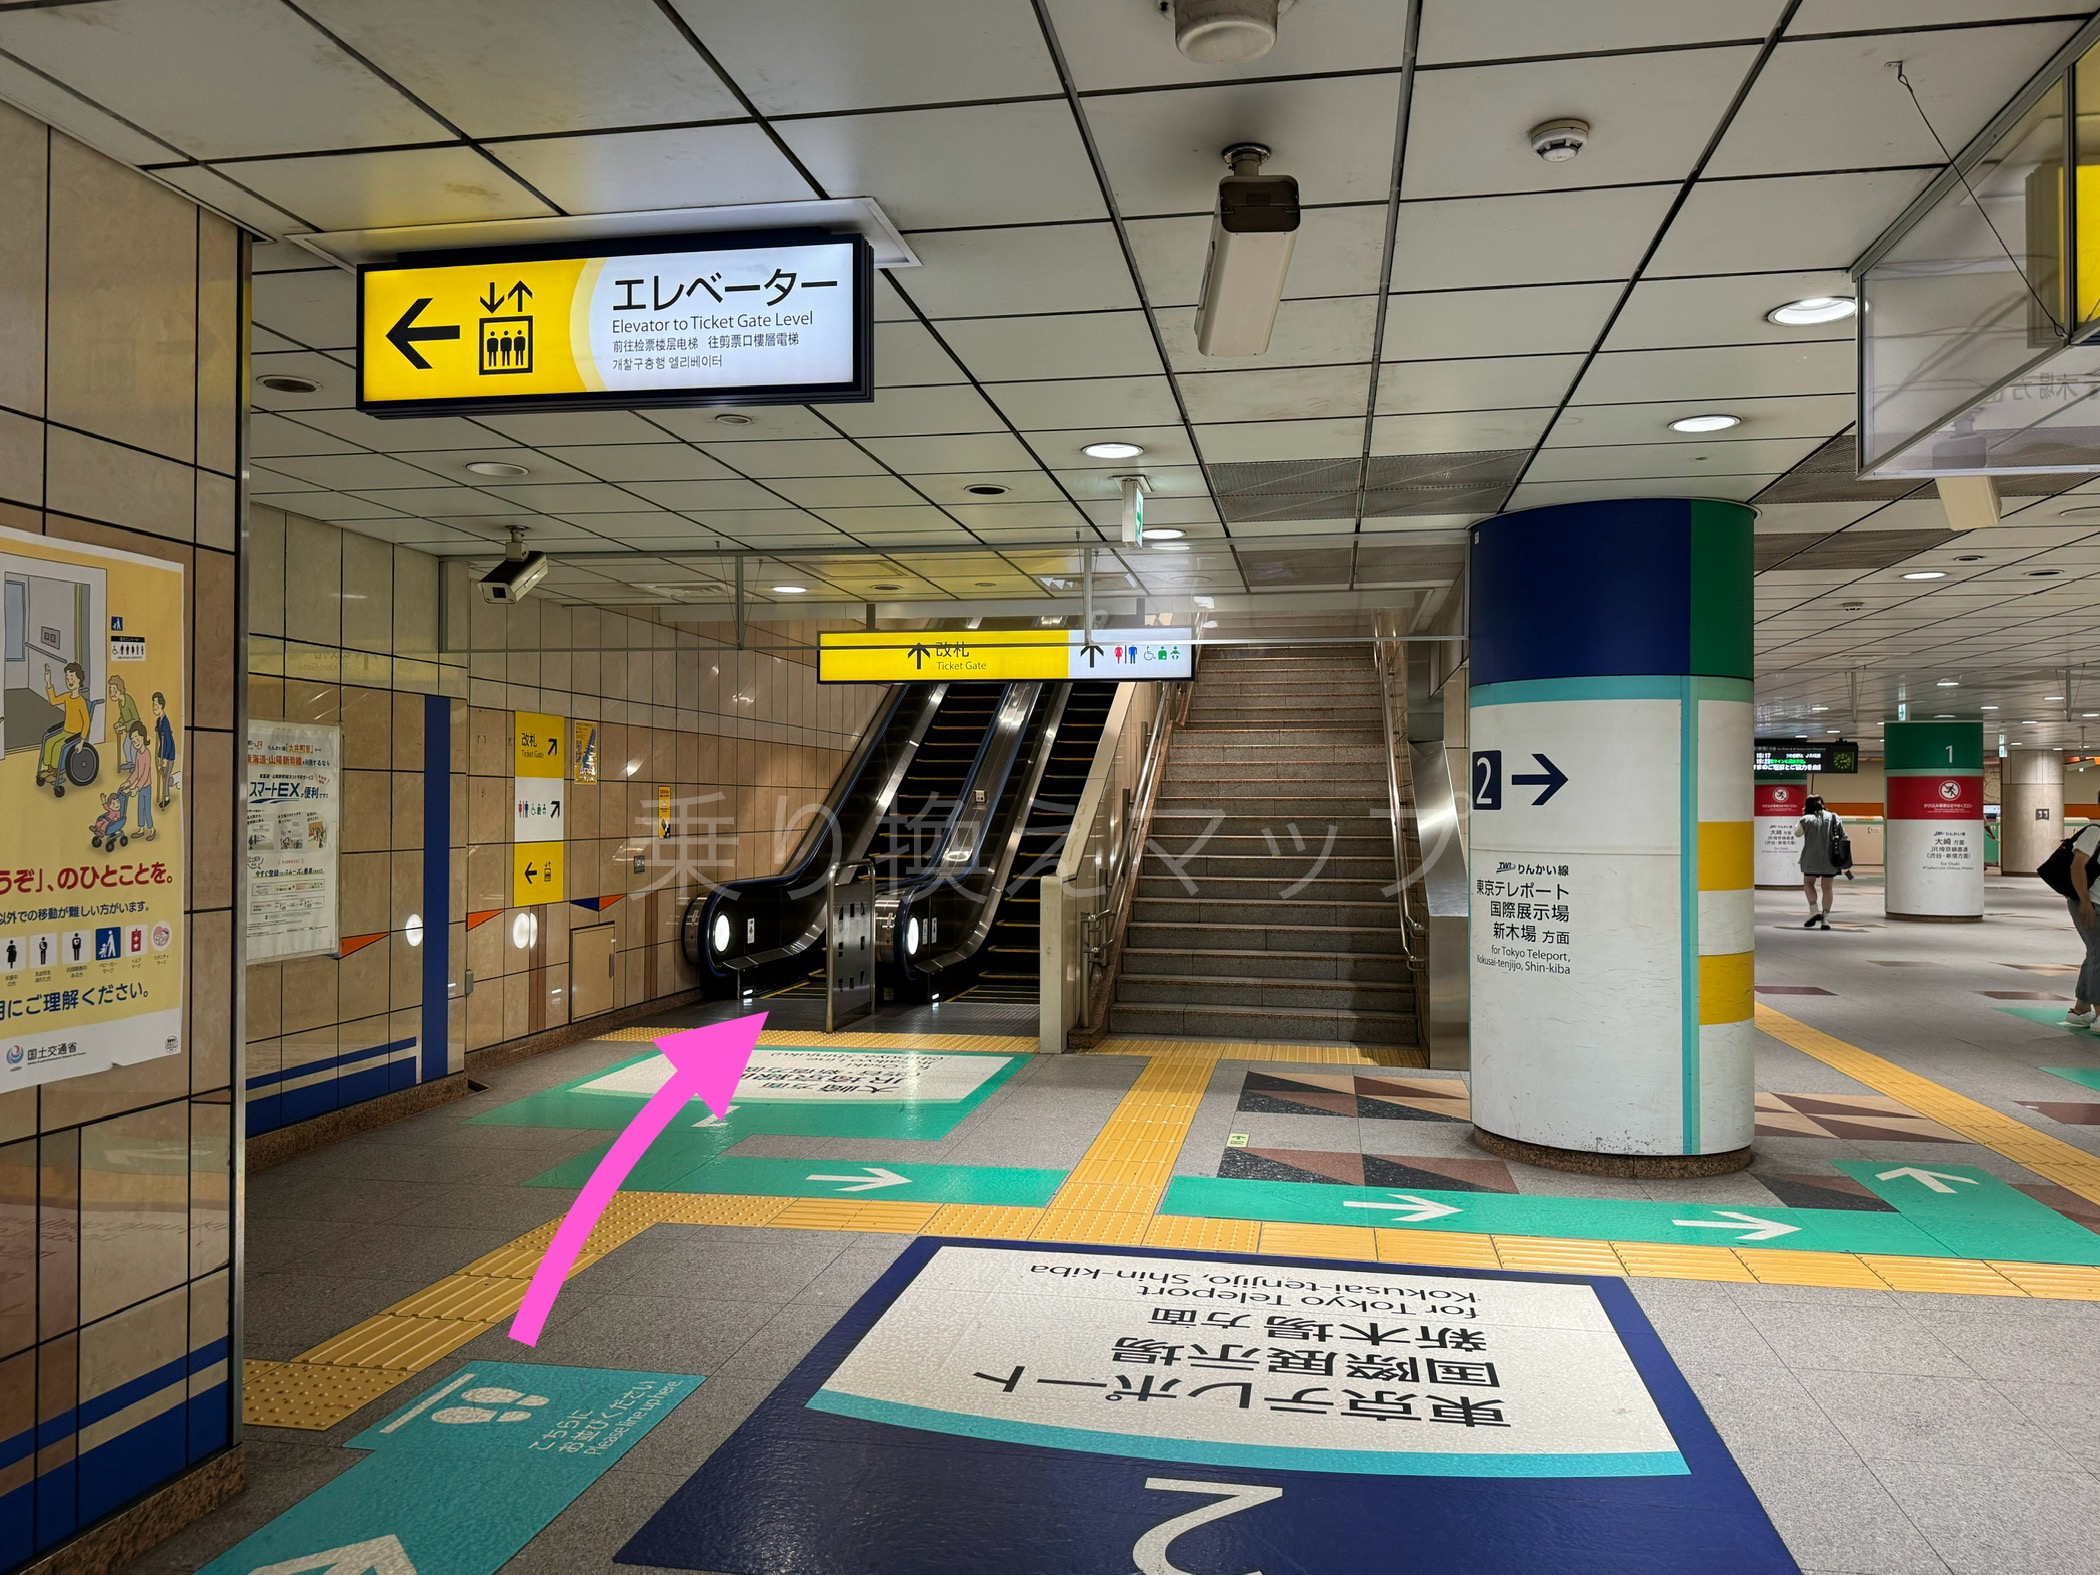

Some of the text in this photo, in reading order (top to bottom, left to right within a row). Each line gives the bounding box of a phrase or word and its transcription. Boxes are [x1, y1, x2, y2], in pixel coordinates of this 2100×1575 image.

[613, 268, 838, 311] エレベーター
[612, 311, 813, 334] Elevator to Ticket Gate Level
[612, 336, 699, 353] 前往检票楼层电梯
[668, 354, 722, 369] 엘리베이터
[936, 641, 970, 658] 改札
[937, 660, 987, 671] Ticket Gate
[521, 732, 538, 748] 改札
[521, 749, 544, 759] Ticket Gate
[1945, 744, 1953, 764] 1
[1476, 756, 1493, 805] 2
[1518, 864, 1569, 877] りんかい線
[1476, 879, 1570, 901] 東京テレポート
[1490, 900, 1570, 924] 国際展示場
[1493, 921, 1570, 945] 新木場 方面
[1476, 954, 1571, 975] Kokusai-tenjijo, Shin-kiba
[1491, 945, 1571, 963] for Tokyo Teleport,
[0, 982, 149, 1021] にご理解ください。
[27, 1041, 77, 1061] 国土交通省
[817, 1084, 899, 1093] 大崎
[1031, 1264, 1481, 1303] Kokusai-tenjijo, Shin-kiba
[1137, 1285, 1480, 1320] for Tokyo Teleport
[1148, 1307, 1487, 1352] 新木場 方面
[1111, 1337, 1500, 1388] 国際展示場
[973, 1366, 1511, 1428] 東京テレポート
[559, 1380, 656, 1453] お並びください
[584, 1380, 684, 1456] Please line up here.
[528, 1410, 593, 1451] こちらに
[1132, 1477, 1283, 1575] 2
